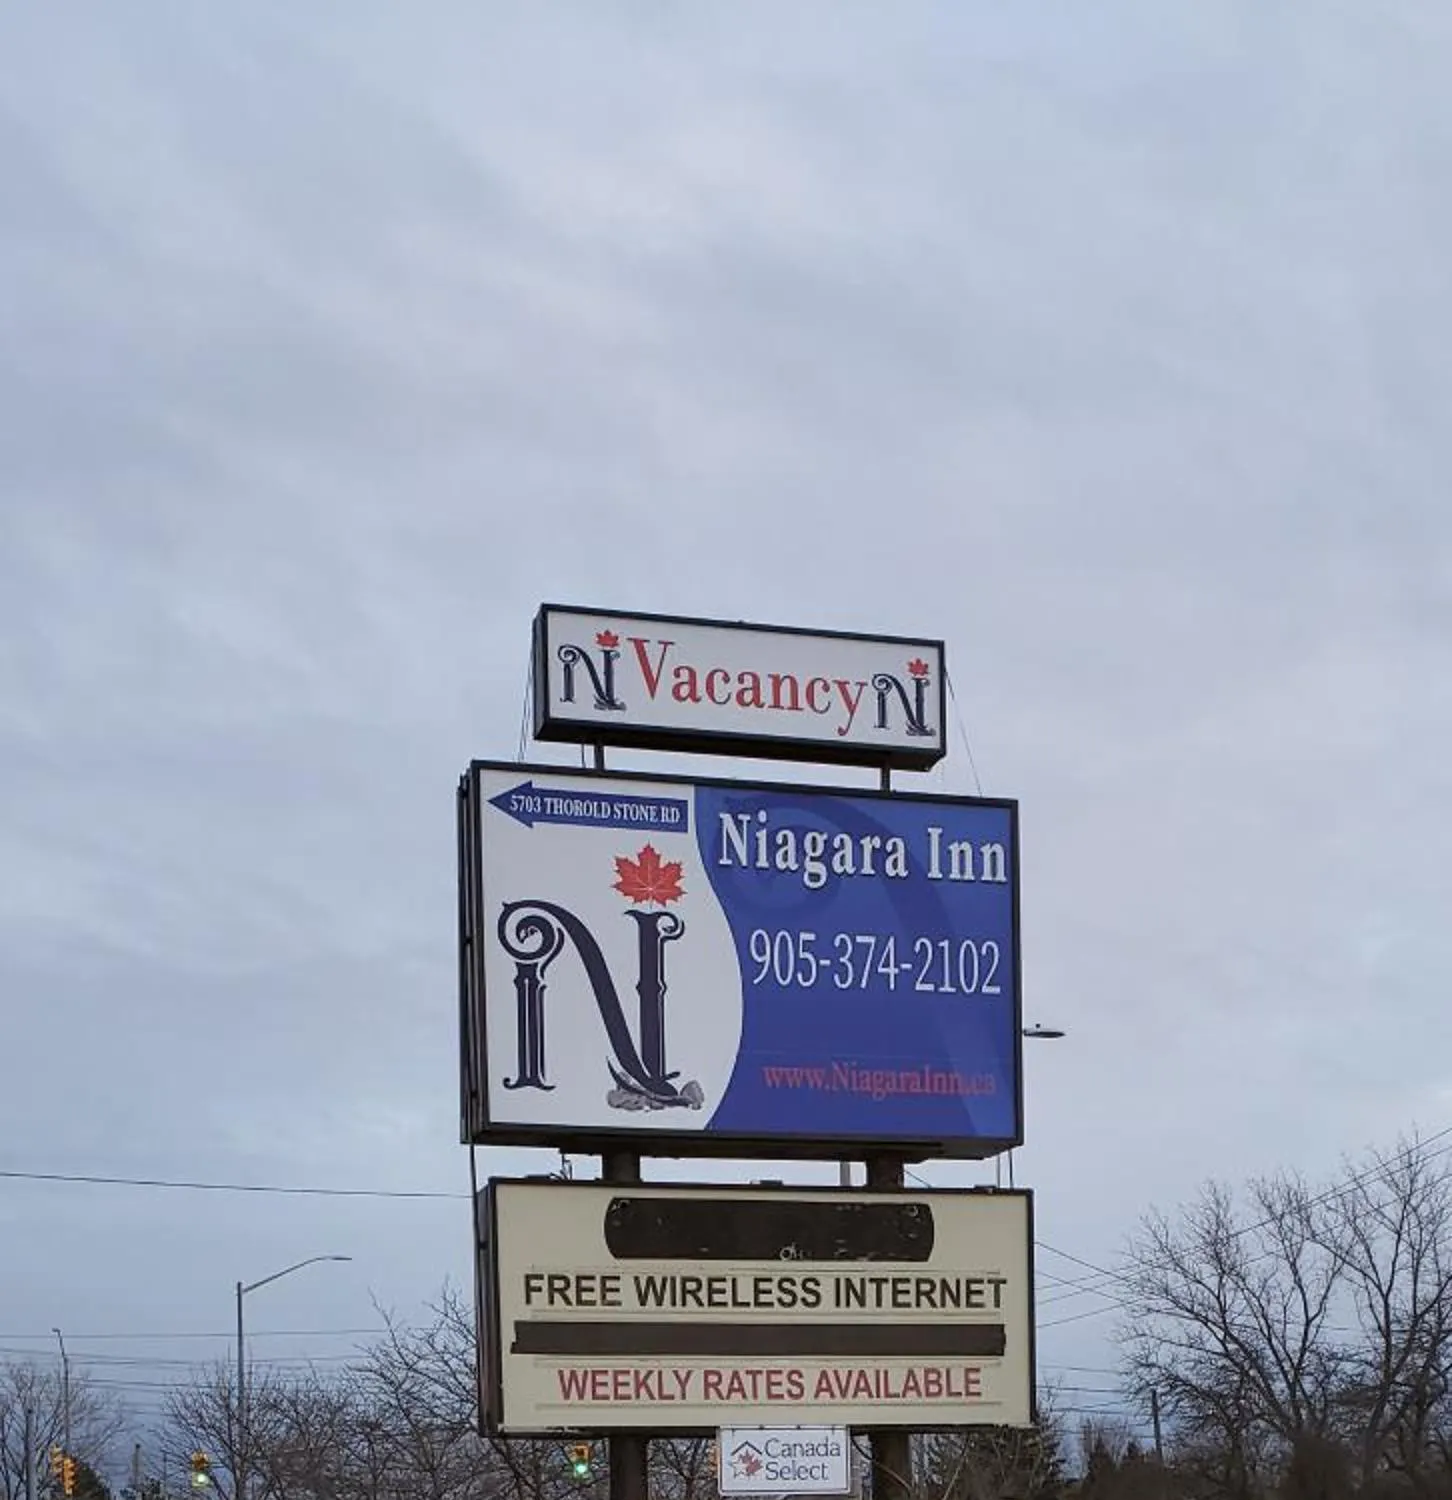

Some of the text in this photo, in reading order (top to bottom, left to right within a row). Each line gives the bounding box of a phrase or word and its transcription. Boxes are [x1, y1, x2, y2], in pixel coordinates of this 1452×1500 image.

[627, 637, 868, 737] Vacancy
[510, 795, 680, 823] 5703 THOROLD STONE RD
[718, 809, 1008, 889] Niagara Inn
[750, 928, 1001, 995] 905-374-2102
[762, 1060, 997, 1101] www.NiagaraInn.ca
[524, 1274, 1008, 1310] FREE WIRELESS INTERNET
[557, 1366, 984, 1402] WEEKLY RATES AVAILABLE
[764, 1436, 841, 1459] Canada
[765, 1460, 830, 1481] Select
